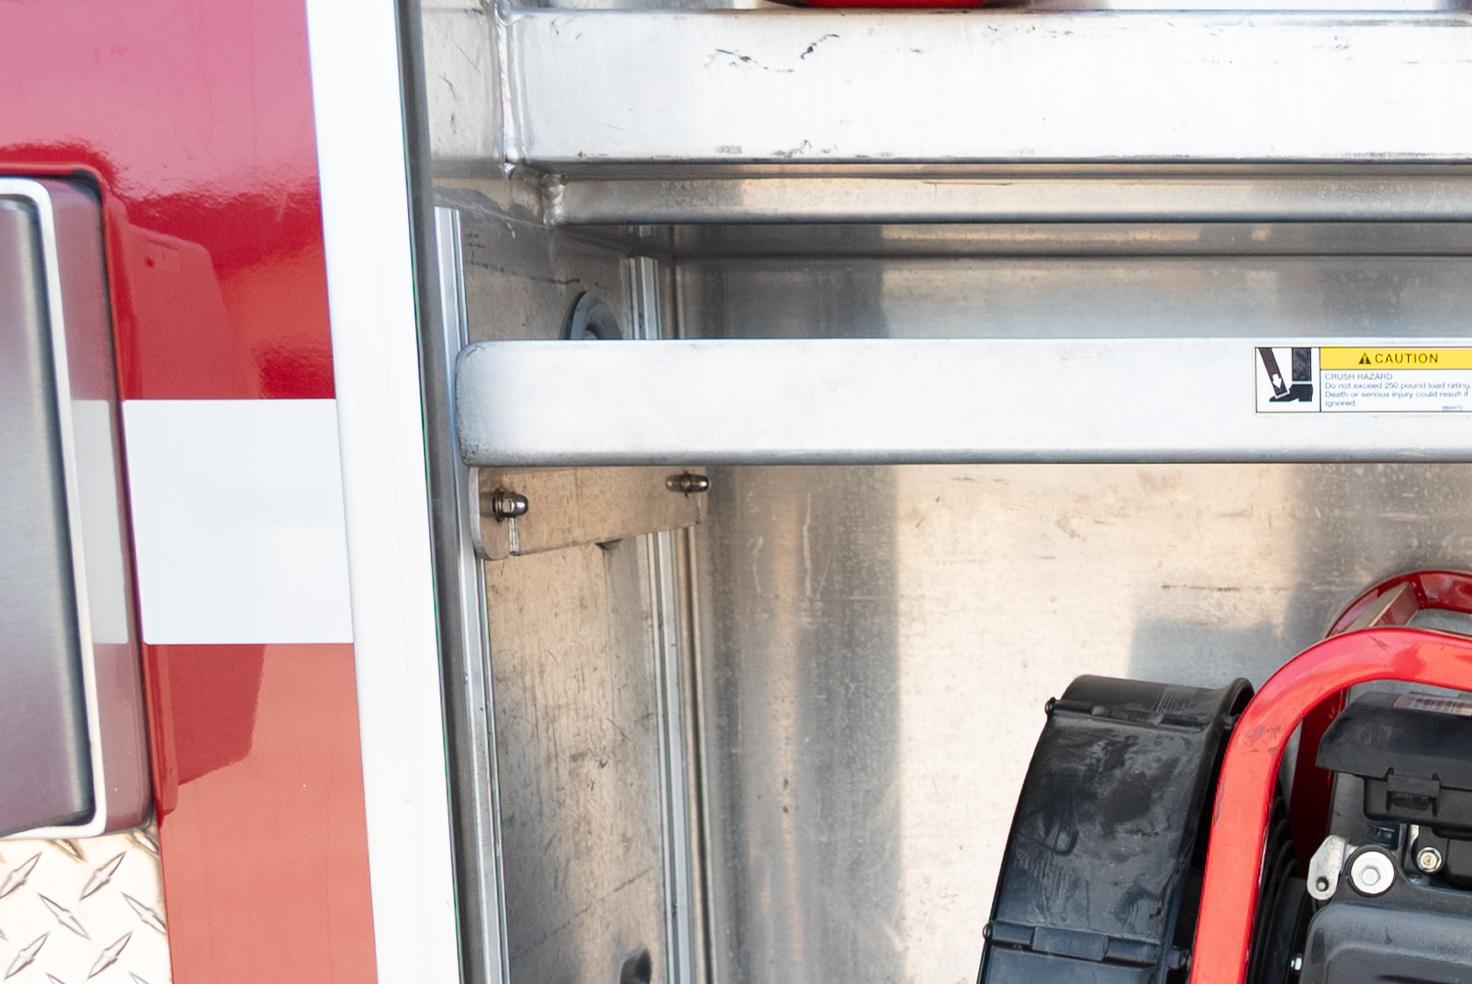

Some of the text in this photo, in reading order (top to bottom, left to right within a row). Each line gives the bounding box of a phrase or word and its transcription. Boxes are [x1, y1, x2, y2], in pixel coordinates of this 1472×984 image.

[1375, 353, 1439, 364] CAUTION
[1324, 373, 1393, 381] CRUSH HAZARD
[1400, 382, 1425, 391] pound
[1392, 391, 1413, 399] injury
